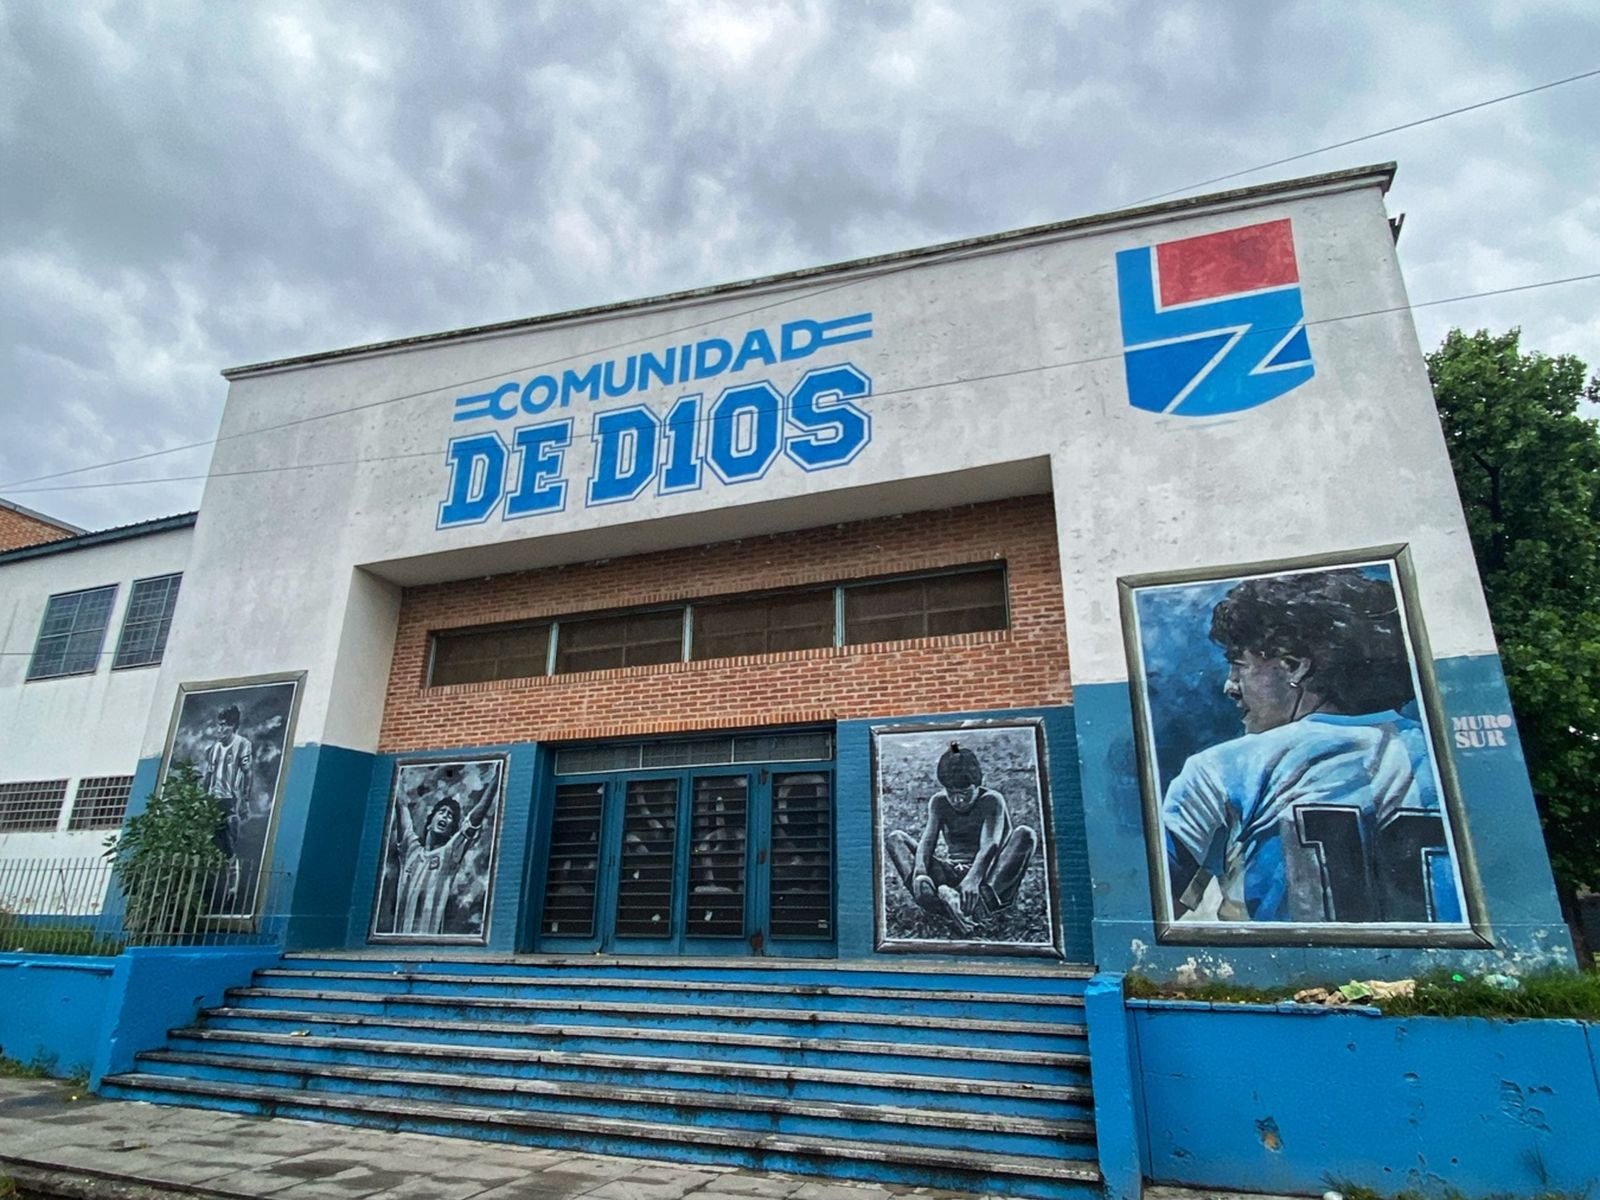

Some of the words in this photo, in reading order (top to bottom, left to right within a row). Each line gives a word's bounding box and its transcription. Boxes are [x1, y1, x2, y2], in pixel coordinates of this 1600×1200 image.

[492, 318, 824, 421] COMUNIDAD
[436, 417, 574, 530] DE
[1451, 714, 1512, 731] MURO
[1454, 729, 1507, 749] SUR
